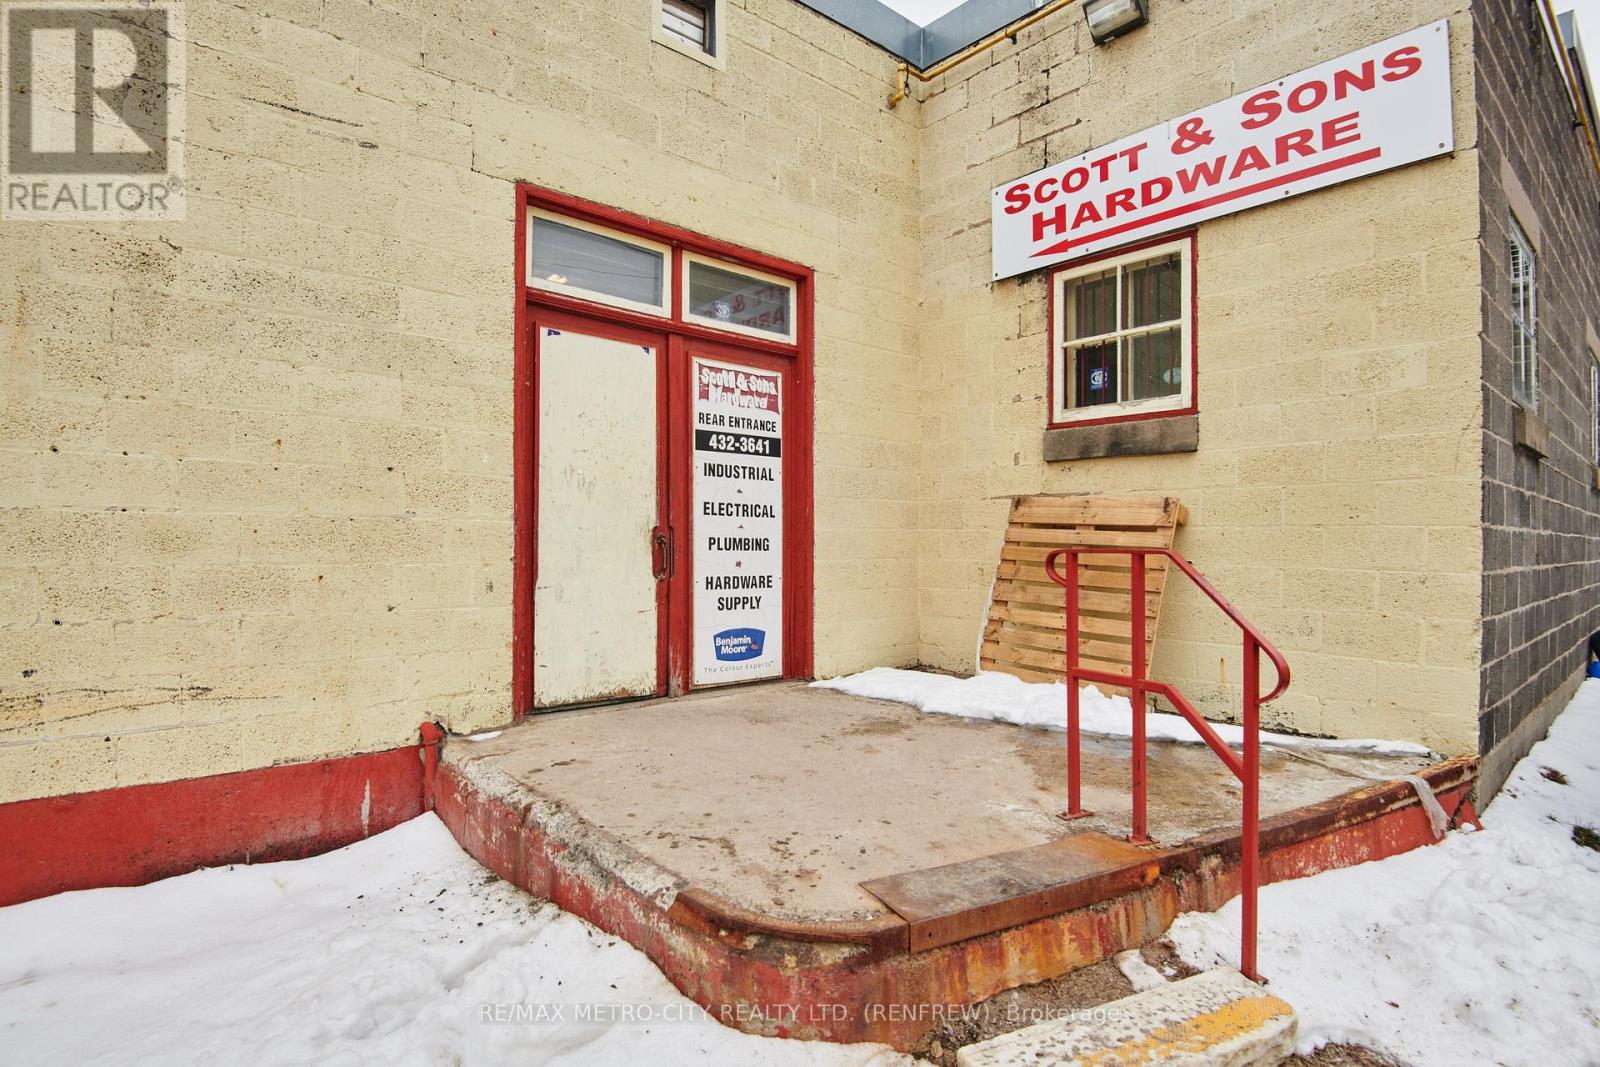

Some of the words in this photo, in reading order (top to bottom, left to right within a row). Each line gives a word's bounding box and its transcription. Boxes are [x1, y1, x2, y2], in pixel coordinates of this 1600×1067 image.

[1004, 143, 1147, 215] SCOTT
[1171, 117, 1213, 155] &
[1240, 46, 1422, 130] SONS
[1031, 112, 1361, 242] HARDWARE
[698, 412, 725, 427] REAR
[728, 416, 777, 433] ENTRANCE
[708, 434, 770, 454] 432-3641
[703, 463, 775, 482] INDUSTRIAL
[703, 502, 776, 518] ELECTRICAL
[708, 537, 770, 552] PLUMBING
[705, 575, 773, 590] HARDWARE
[717, 596, 762, 611] SUPPLY
[715, 635, 752, 647] Benjamin
[719, 664, 743, 673] Colour
